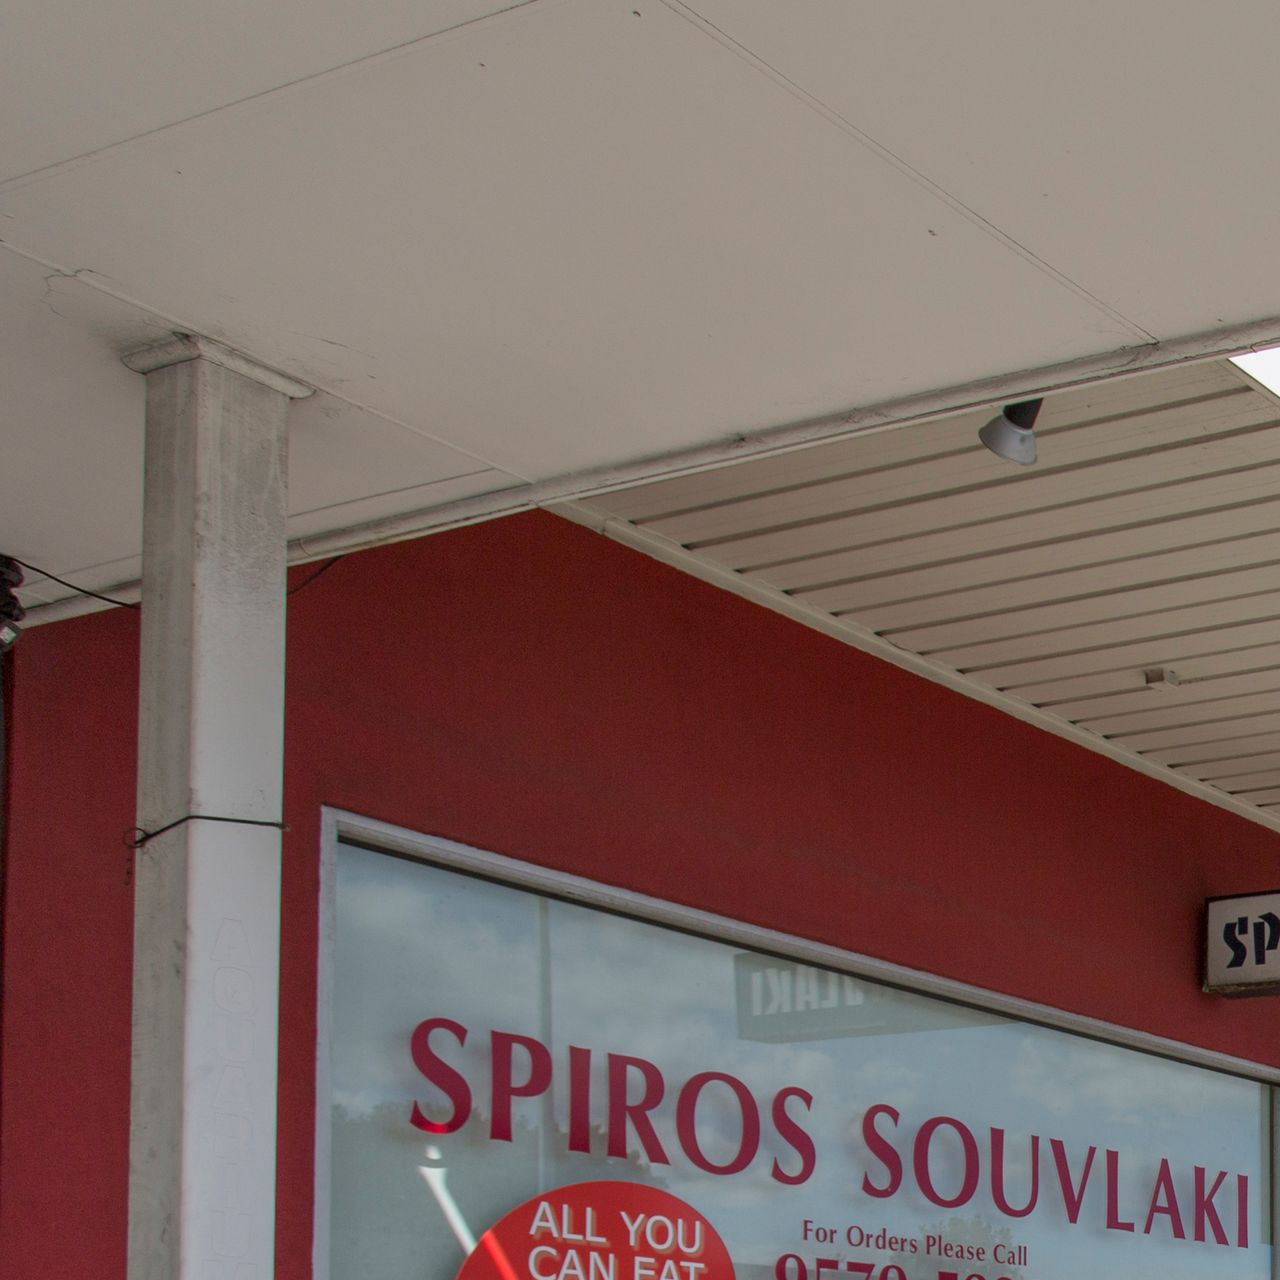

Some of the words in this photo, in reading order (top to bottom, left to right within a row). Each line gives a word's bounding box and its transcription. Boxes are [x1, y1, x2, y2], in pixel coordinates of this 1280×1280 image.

[408, 1016, 817, 1185] SPIROS
[862, 1104, 1250, 1249] SOUVLAKI
[529, 1200, 608, 1245] ALL
[620, 1210, 702, 1254] YOU
[802, 1219, 838, 1244] For
[846, 1225, 918, 1255] Orders
[926, 1235, 986, 1262] Please
[993, 1243, 1028, 1267] Call
